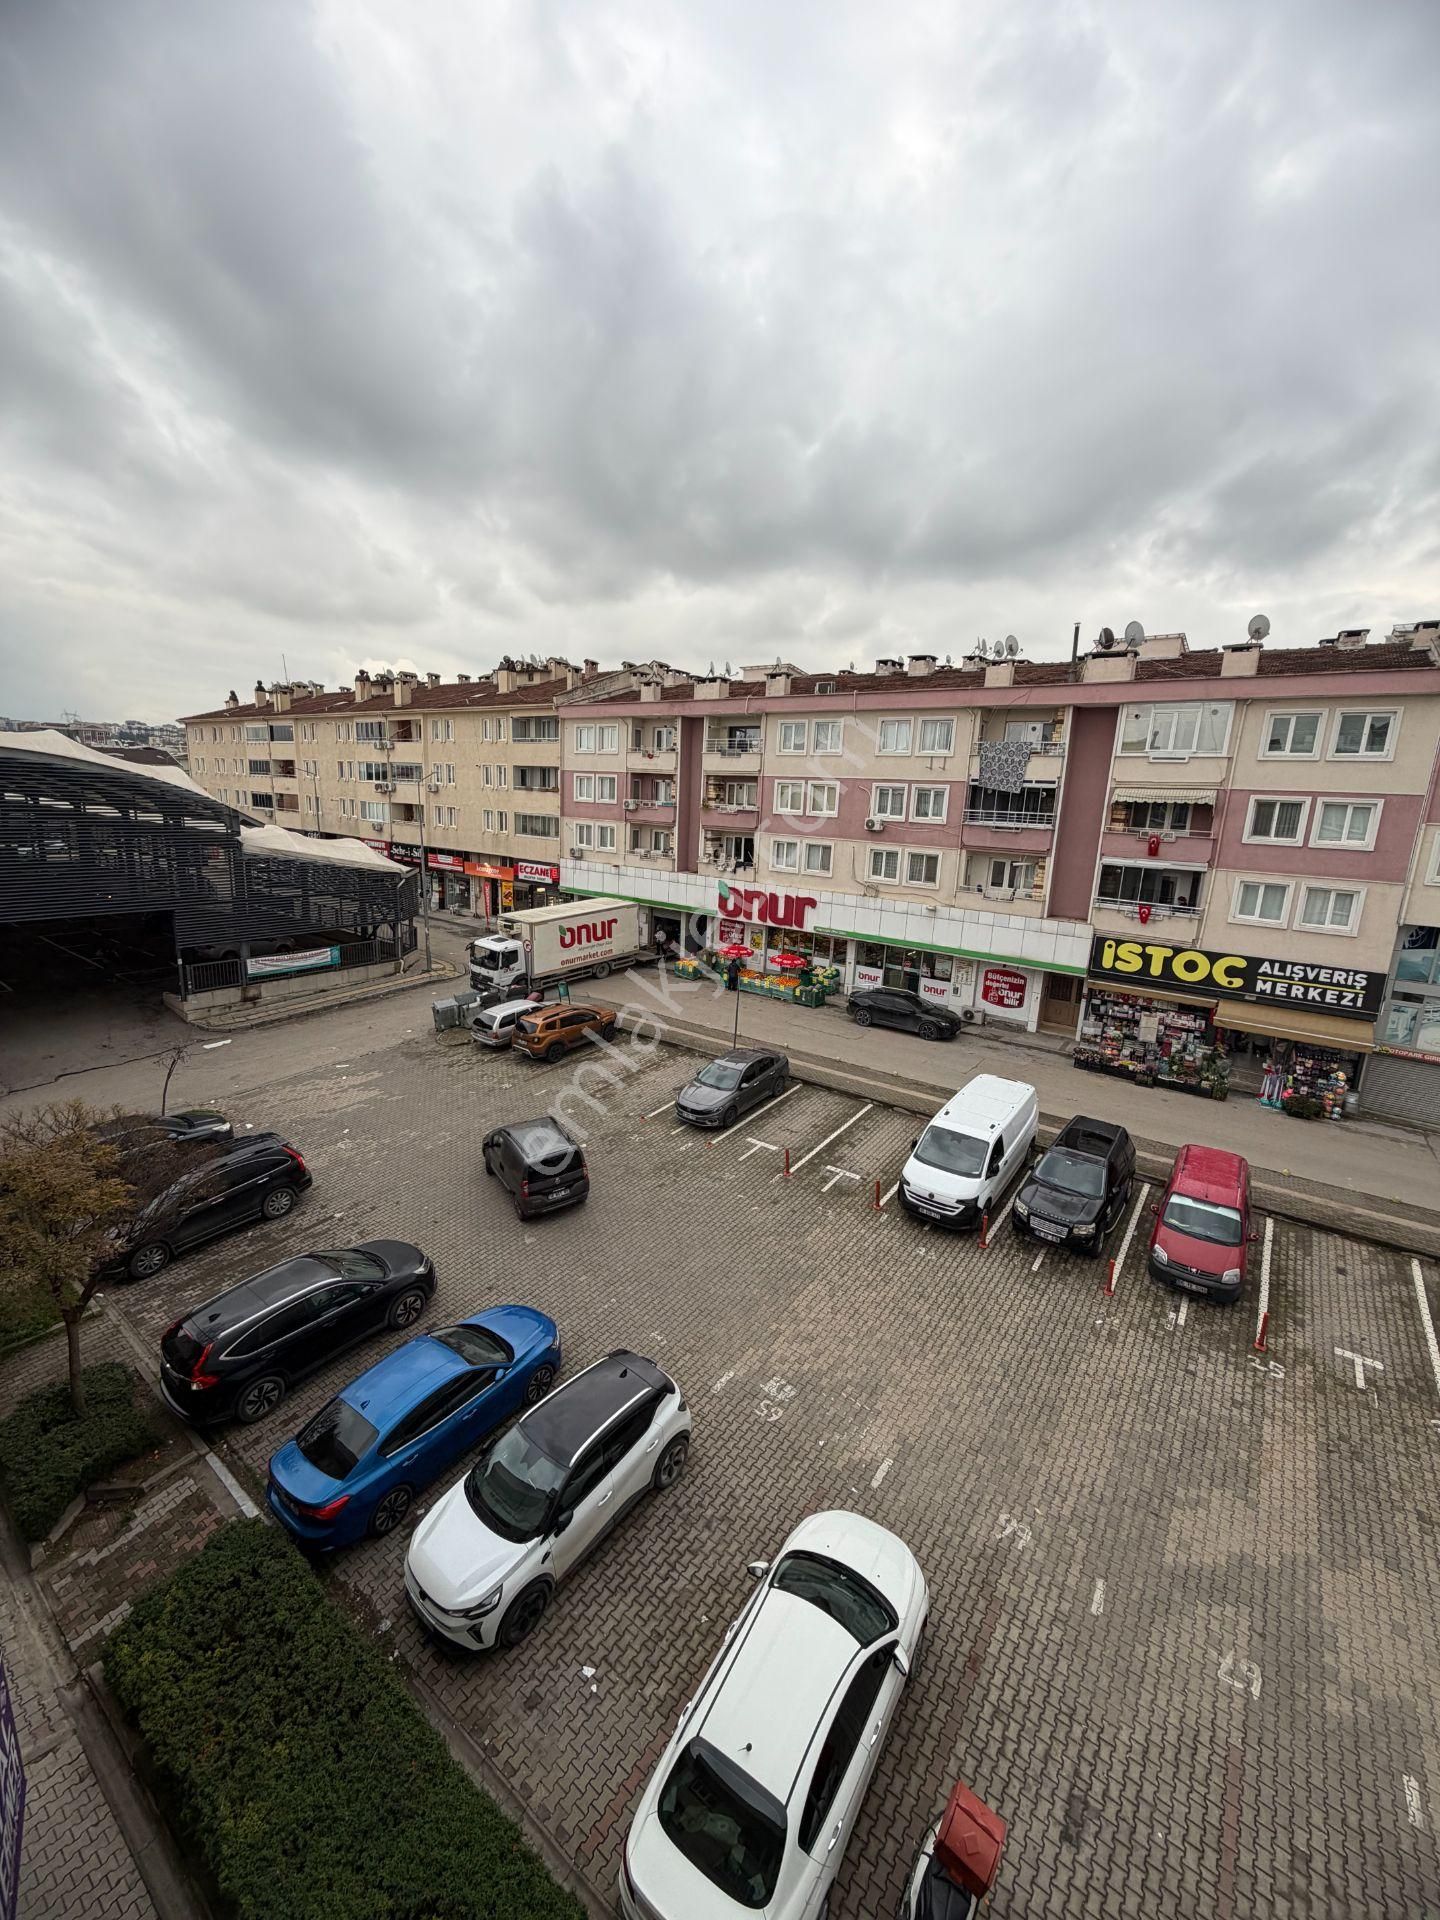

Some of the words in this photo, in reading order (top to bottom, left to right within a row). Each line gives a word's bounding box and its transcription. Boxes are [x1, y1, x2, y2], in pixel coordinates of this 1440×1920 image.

[519, 864, 550, 878] ECZANE
[718, 884, 817, 929] onur
[560, 918, 618, 949] onur
[560, 948, 613, 966] onurmarket.com
[1101, 940, 1248, 988] İSTOÇ
[858, 971, 881, 982] onur
[987, 972, 1024, 985] Bütçenizin
[1257, 960, 1369, 989] ALIŞVERİŞ
[923, 984, 948, 996] onur
[1255, 979, 1364, 1008] MERKEZİ
[1389, 1048, 1424, 1059] OTOPARK
